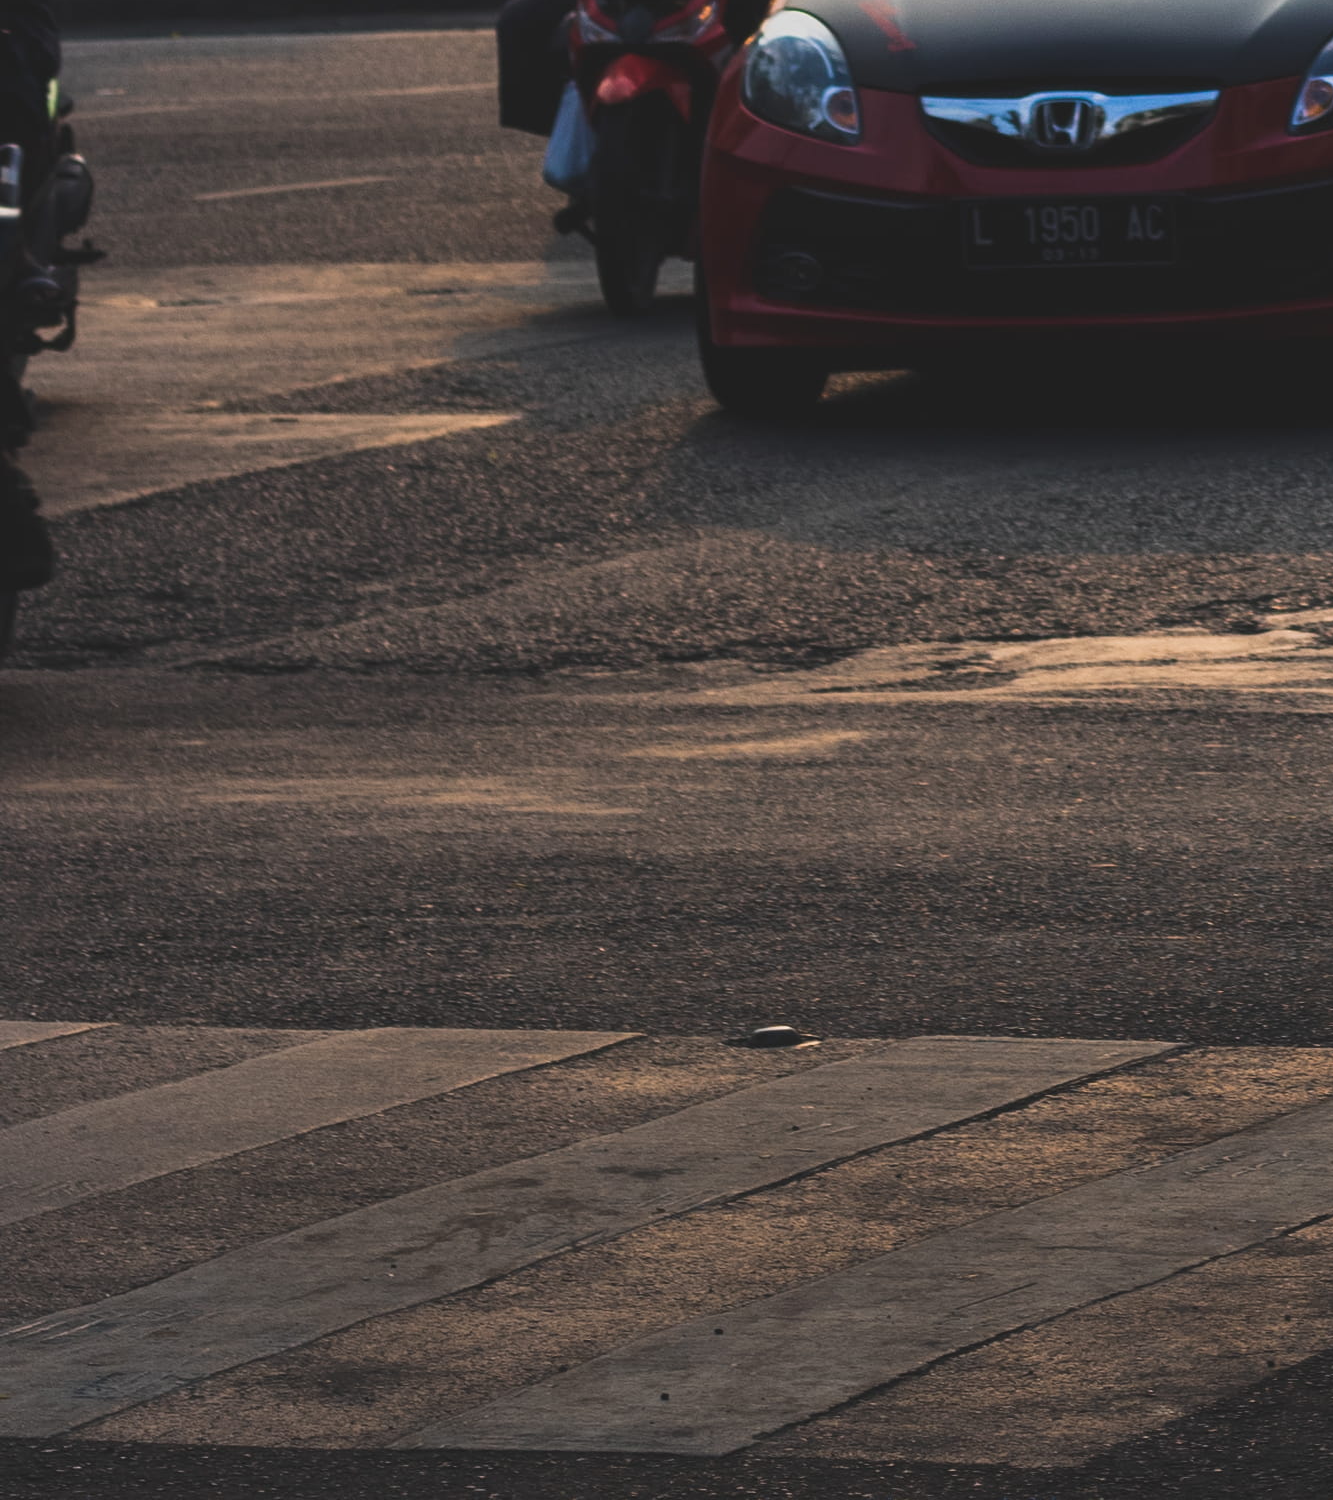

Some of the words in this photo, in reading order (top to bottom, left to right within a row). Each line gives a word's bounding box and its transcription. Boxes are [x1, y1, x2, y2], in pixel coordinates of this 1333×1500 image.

[971, 207, 995, 246] L
[1023, 205, 1101, 245] 1950
[1125, 203, 1167, 242] AC
